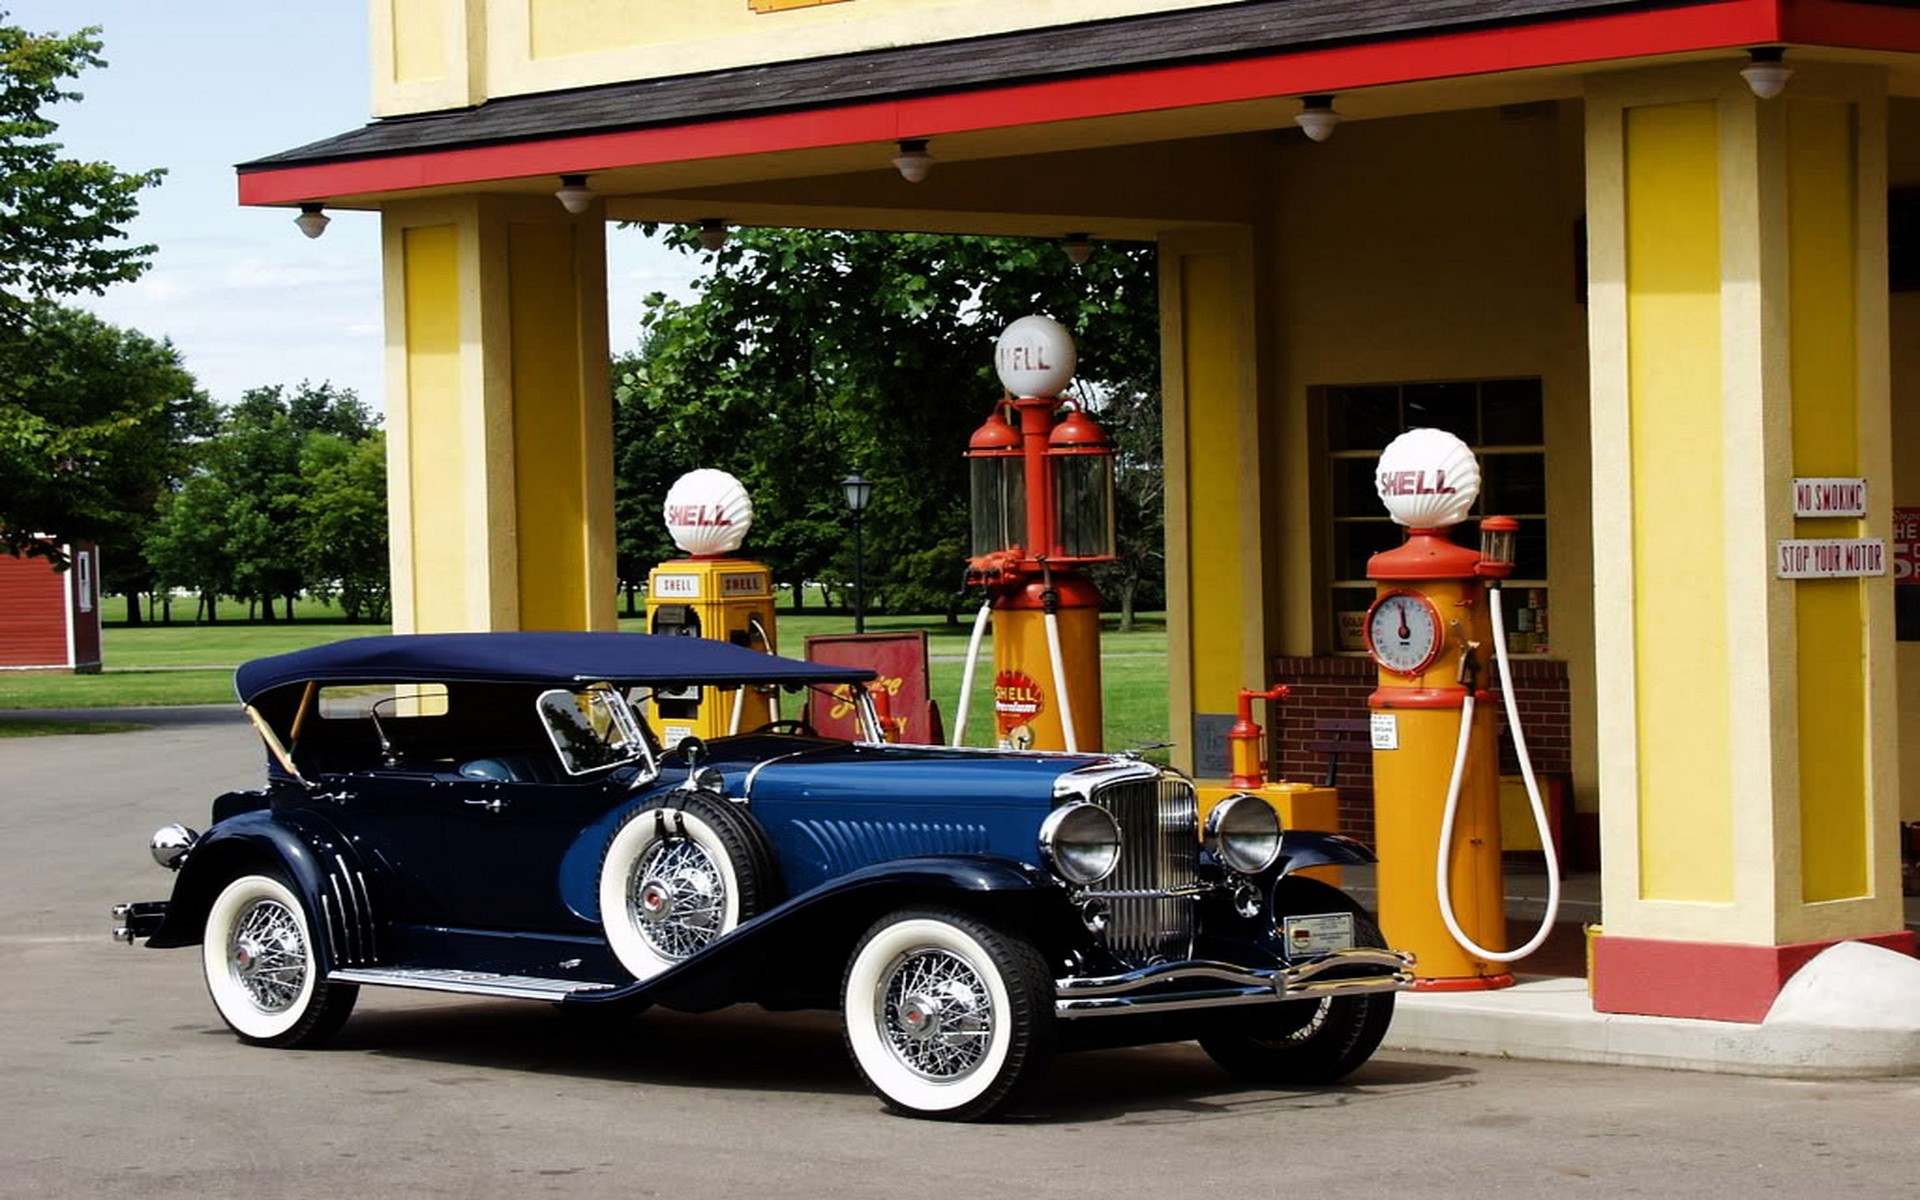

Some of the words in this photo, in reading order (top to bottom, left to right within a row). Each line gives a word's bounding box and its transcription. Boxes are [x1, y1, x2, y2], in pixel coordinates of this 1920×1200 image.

[1380, 469, 1456, 496] SHELL
[1797, 484, 1812, 511] NO
[1815, 484, 1863, 511] SMOKING
[668, 504, 734, 527] SHELL
[1781, 546, 1810, 573] STOP
[1814, 545, 1841, 572] YOUR
[1845, 544, 1882, 571] MOTOR
[664, 579, 692, 591] SHELL
[724, 573, 760, 591] SHELL
[995, 686, 1036, 702] SHELL
